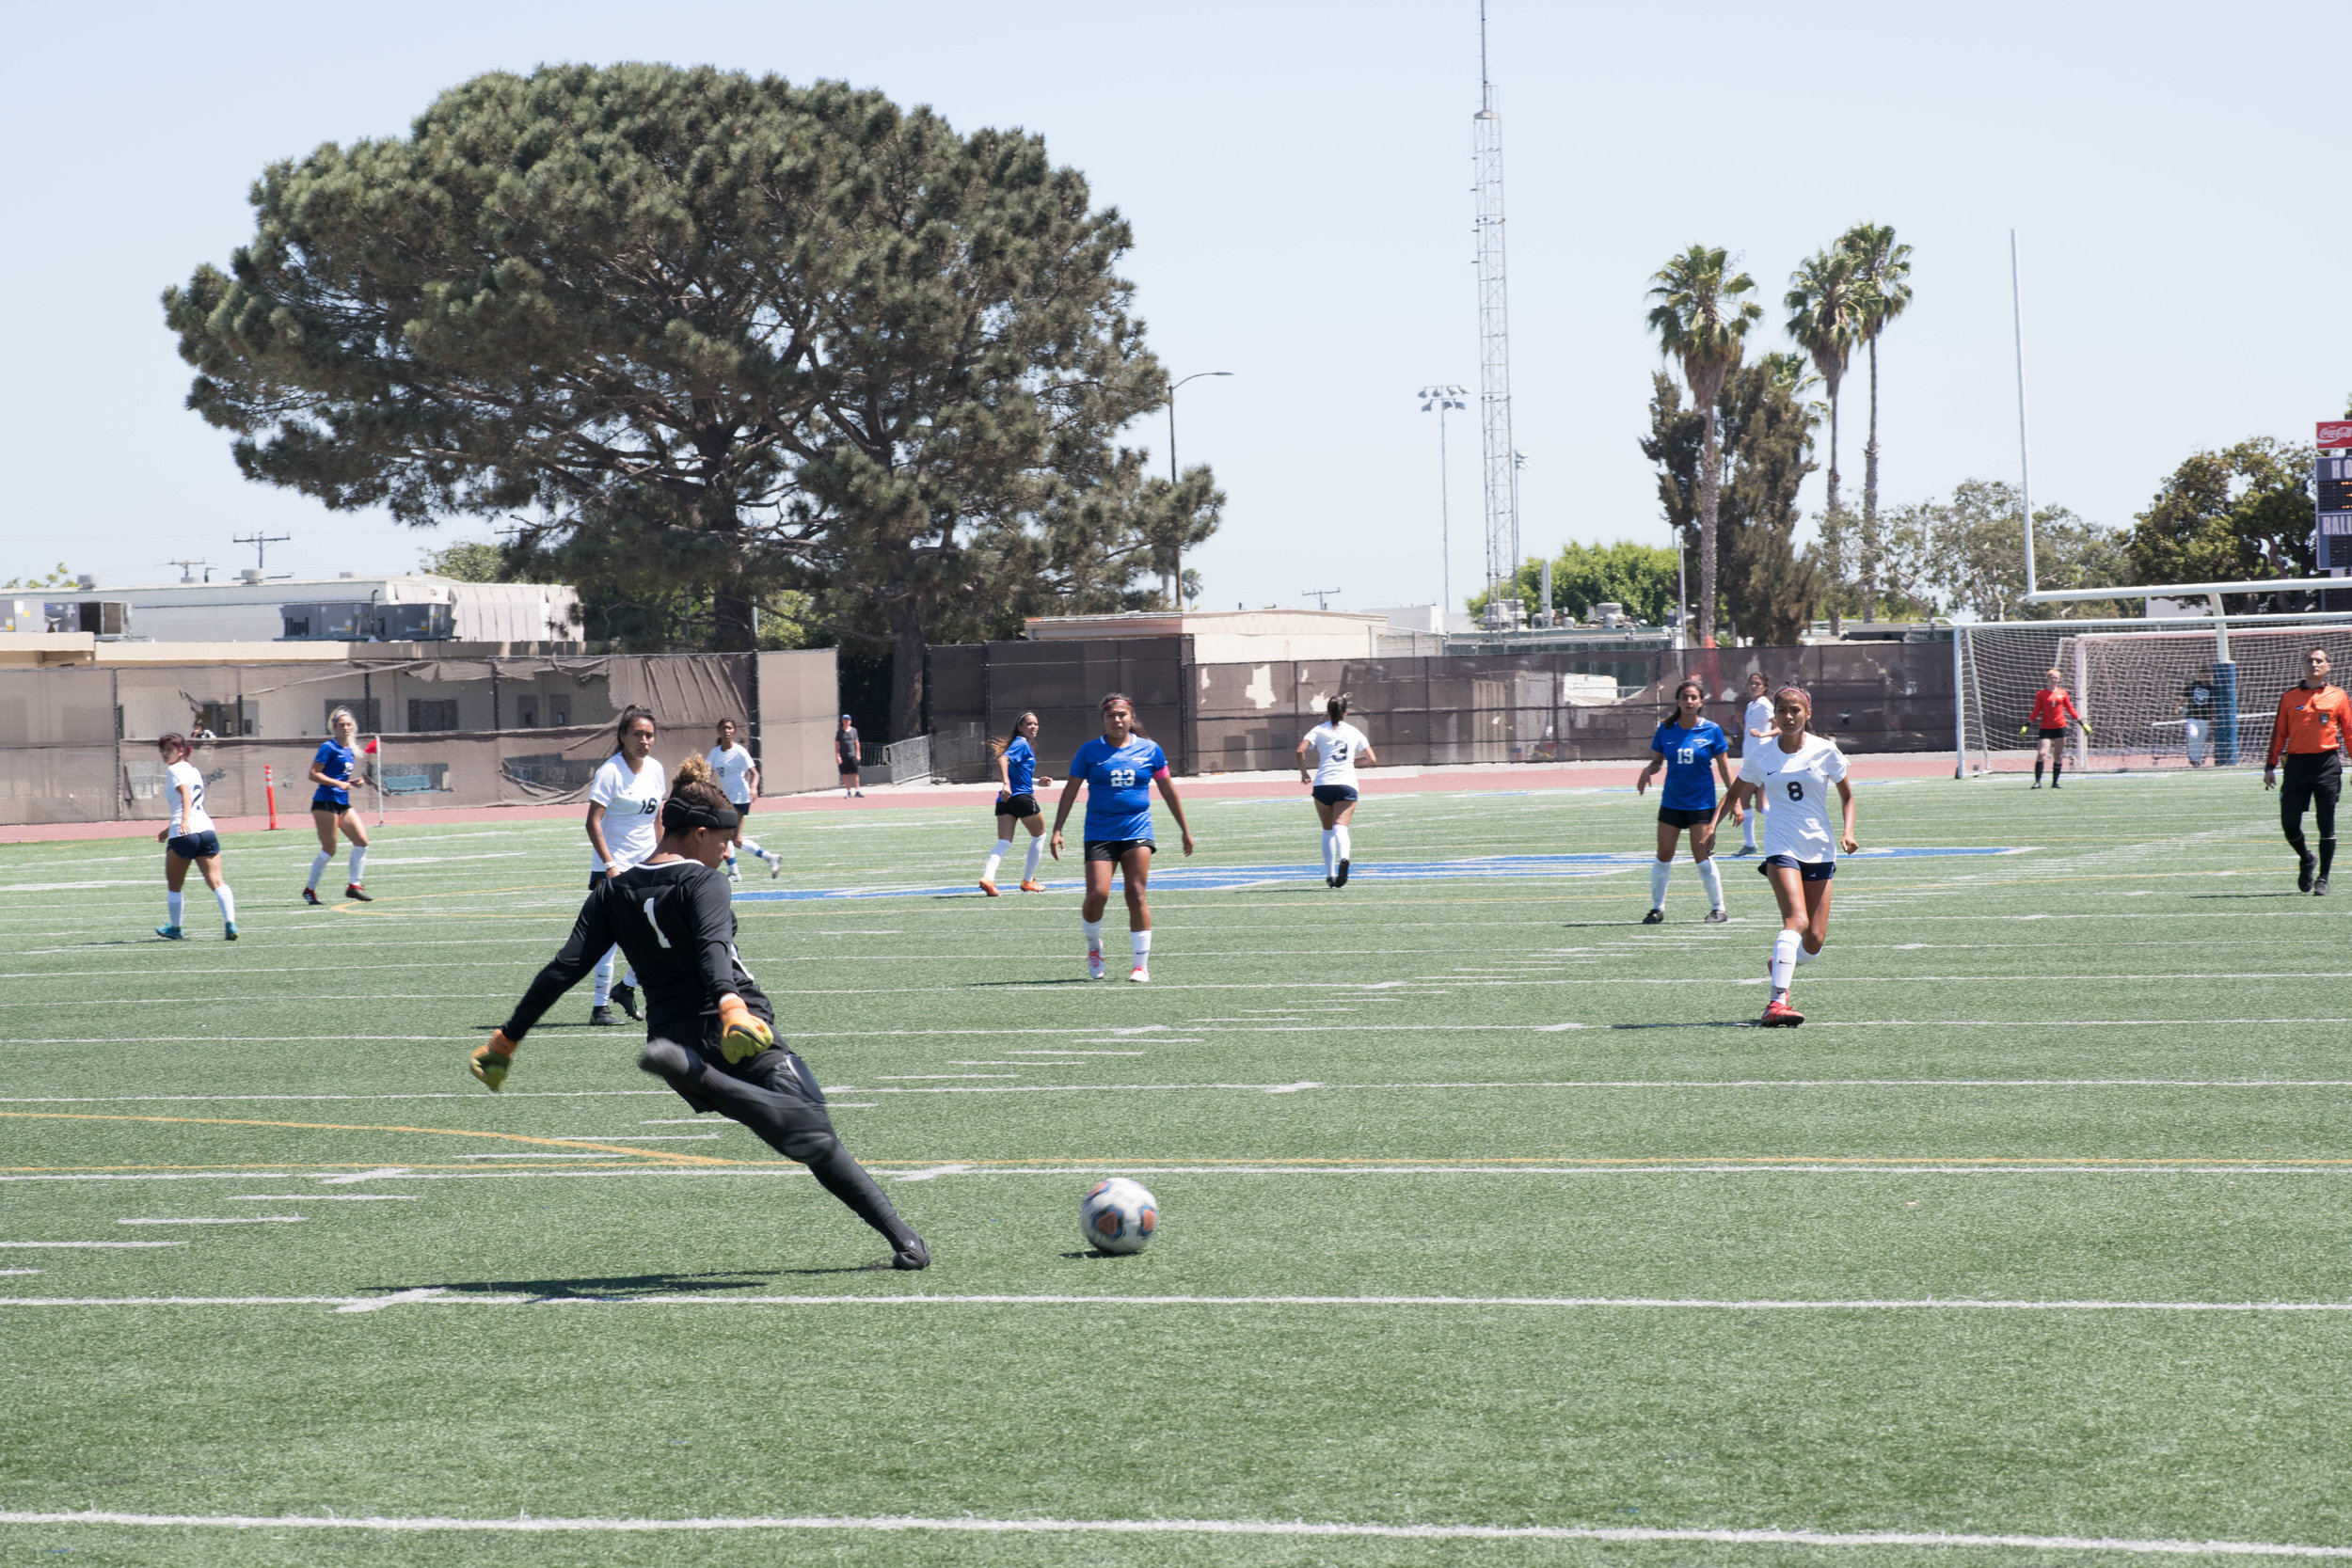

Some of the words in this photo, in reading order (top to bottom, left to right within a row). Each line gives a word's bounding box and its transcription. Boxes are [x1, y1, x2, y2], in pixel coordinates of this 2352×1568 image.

[1331, 739, 1348, 763] 3
[1677, 748, 1694, 764] 19
[1110, 768, 1136, 786] 23
[1787, 781, 1804, 801] 8
[638, 798, 658, 815] 16
[644, 897, 672, 949] 1
